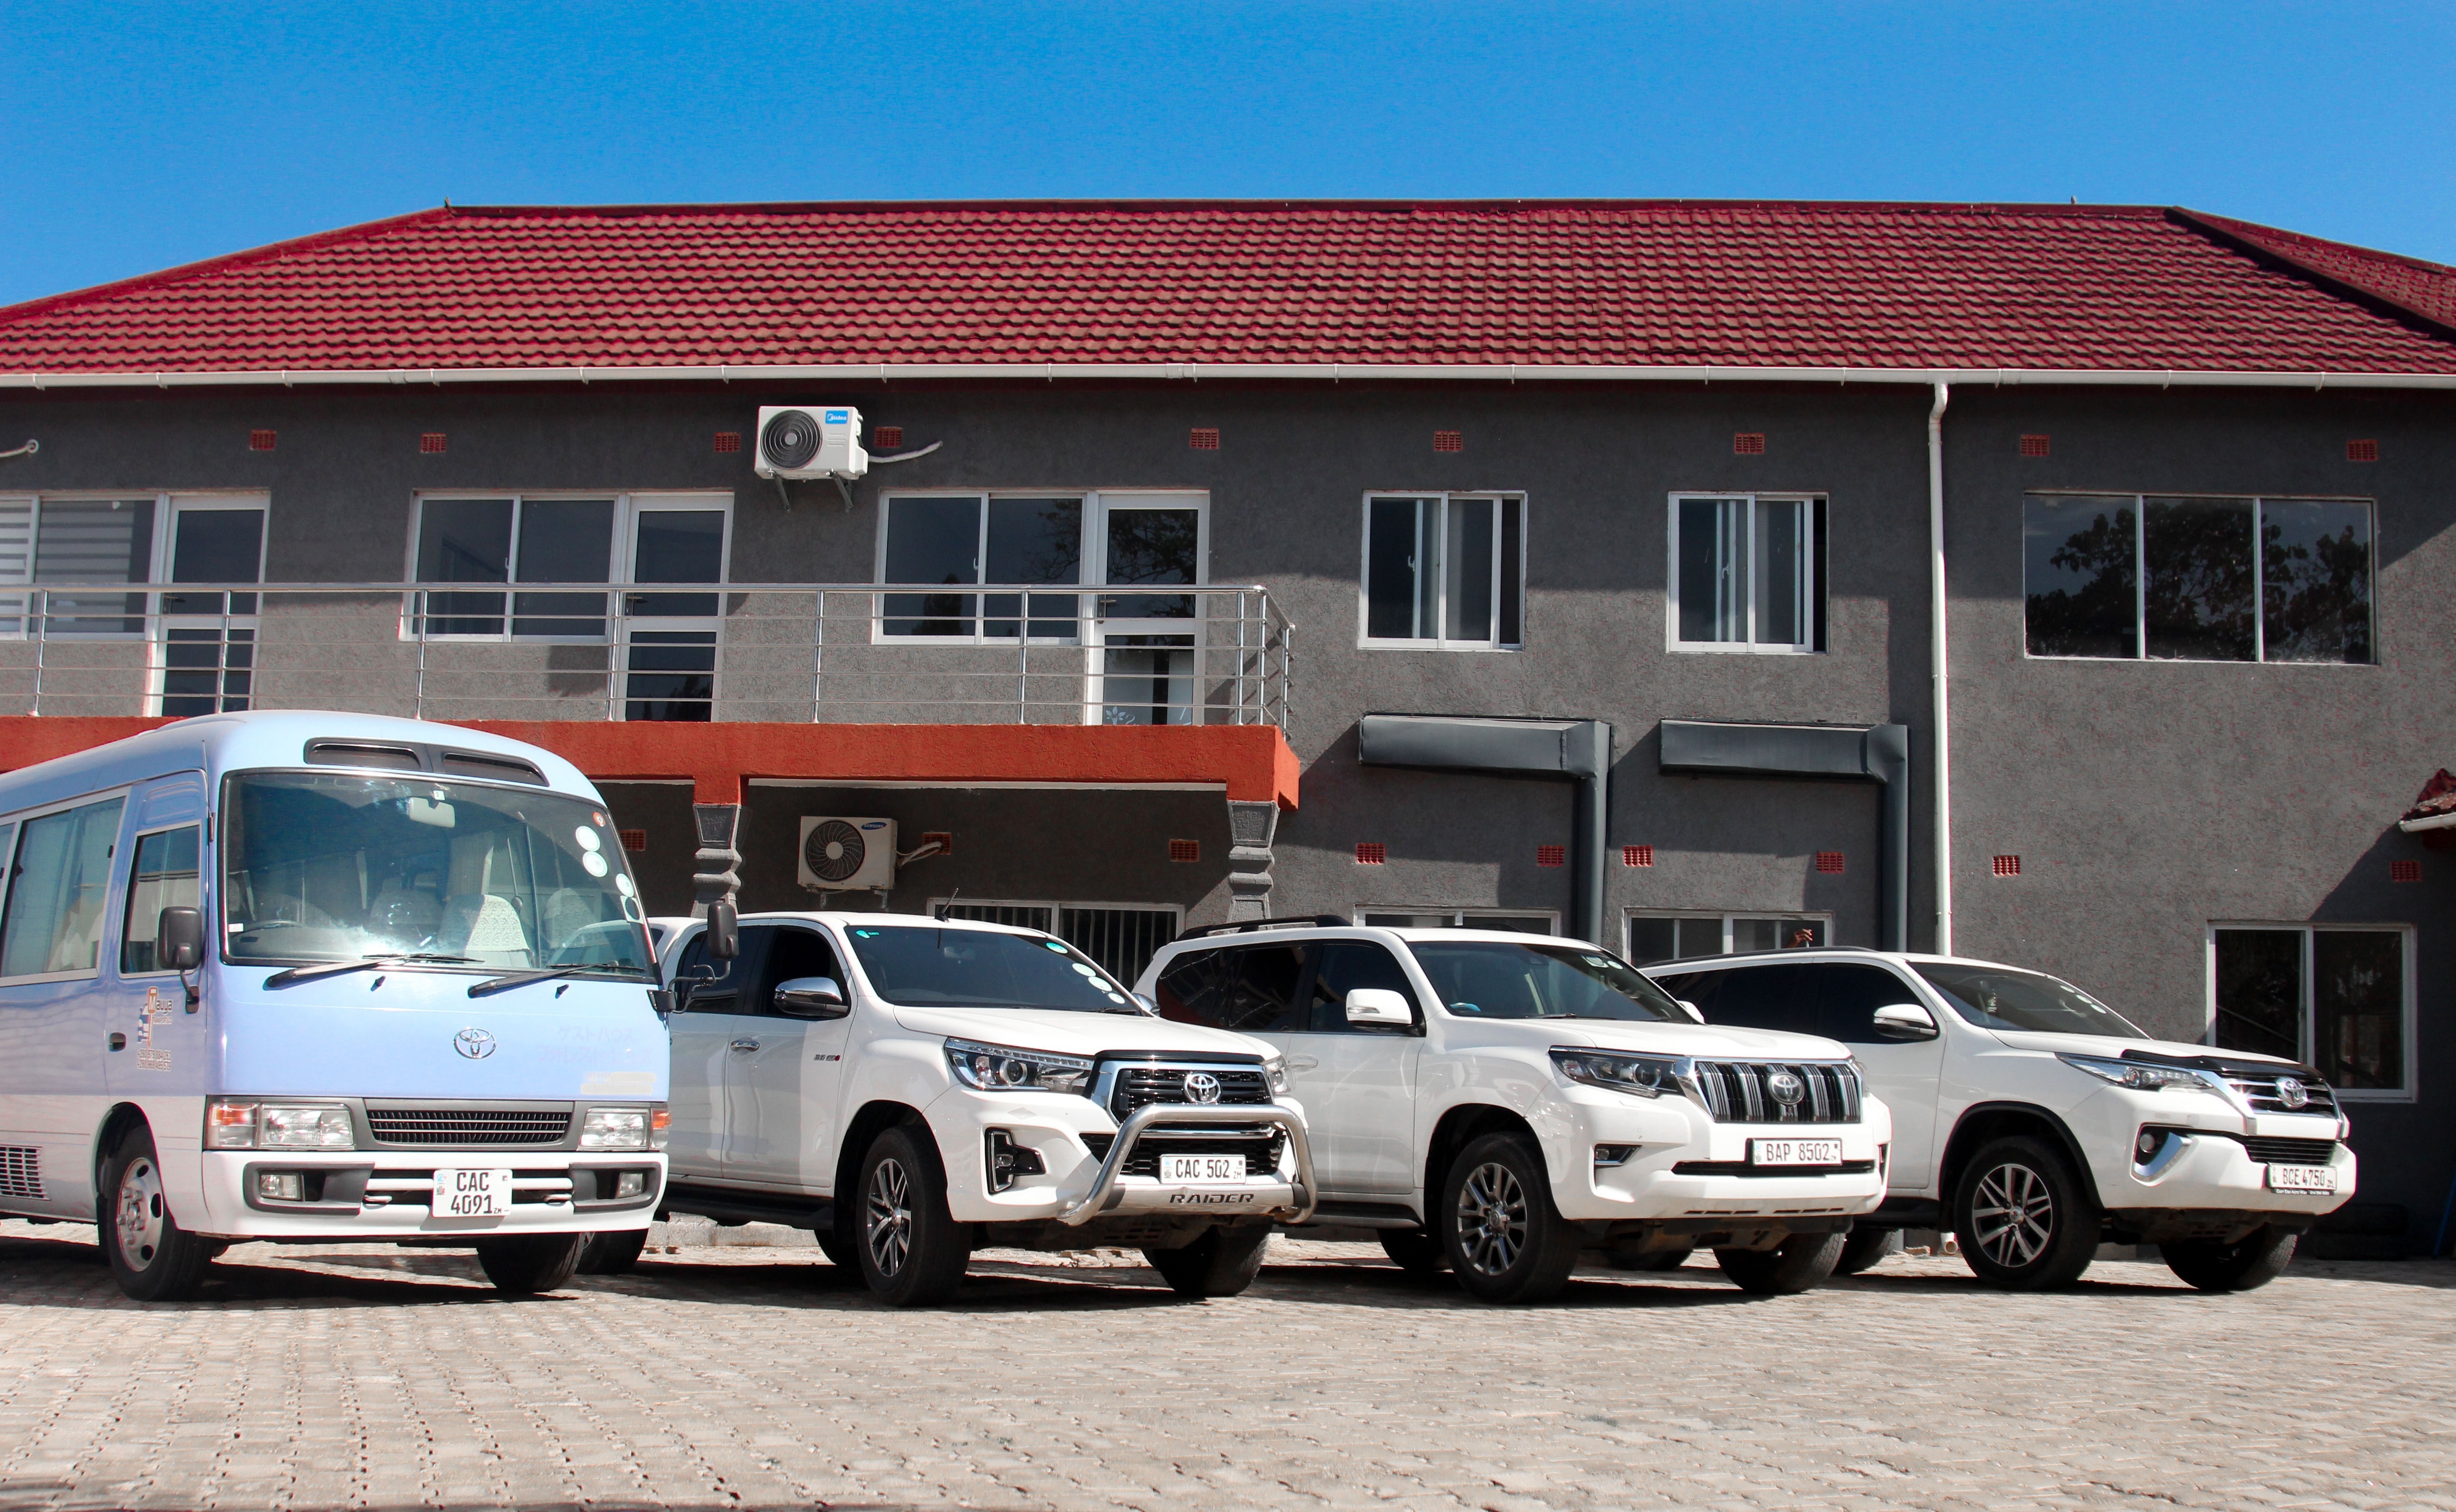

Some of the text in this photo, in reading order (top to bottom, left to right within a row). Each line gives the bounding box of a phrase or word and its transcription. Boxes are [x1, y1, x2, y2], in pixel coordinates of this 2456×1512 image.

[149, 995, 172, 1014] Mauya
[1766, 1143, 1790, 1161] BAP
[1799, 1143, 1830, 1161] 8502
[1176, 1159, 1242, 1179] CAC 502 ZM
[2283, 1168, 2300, 1185] BCE
[2302, 1169, 2325, 1186] 4750
[457, 1172, 489, 1191] CAC
[451, 1195, 492, 1214] 4091
[1169, 1194, 1255, 1204] RAIDER
